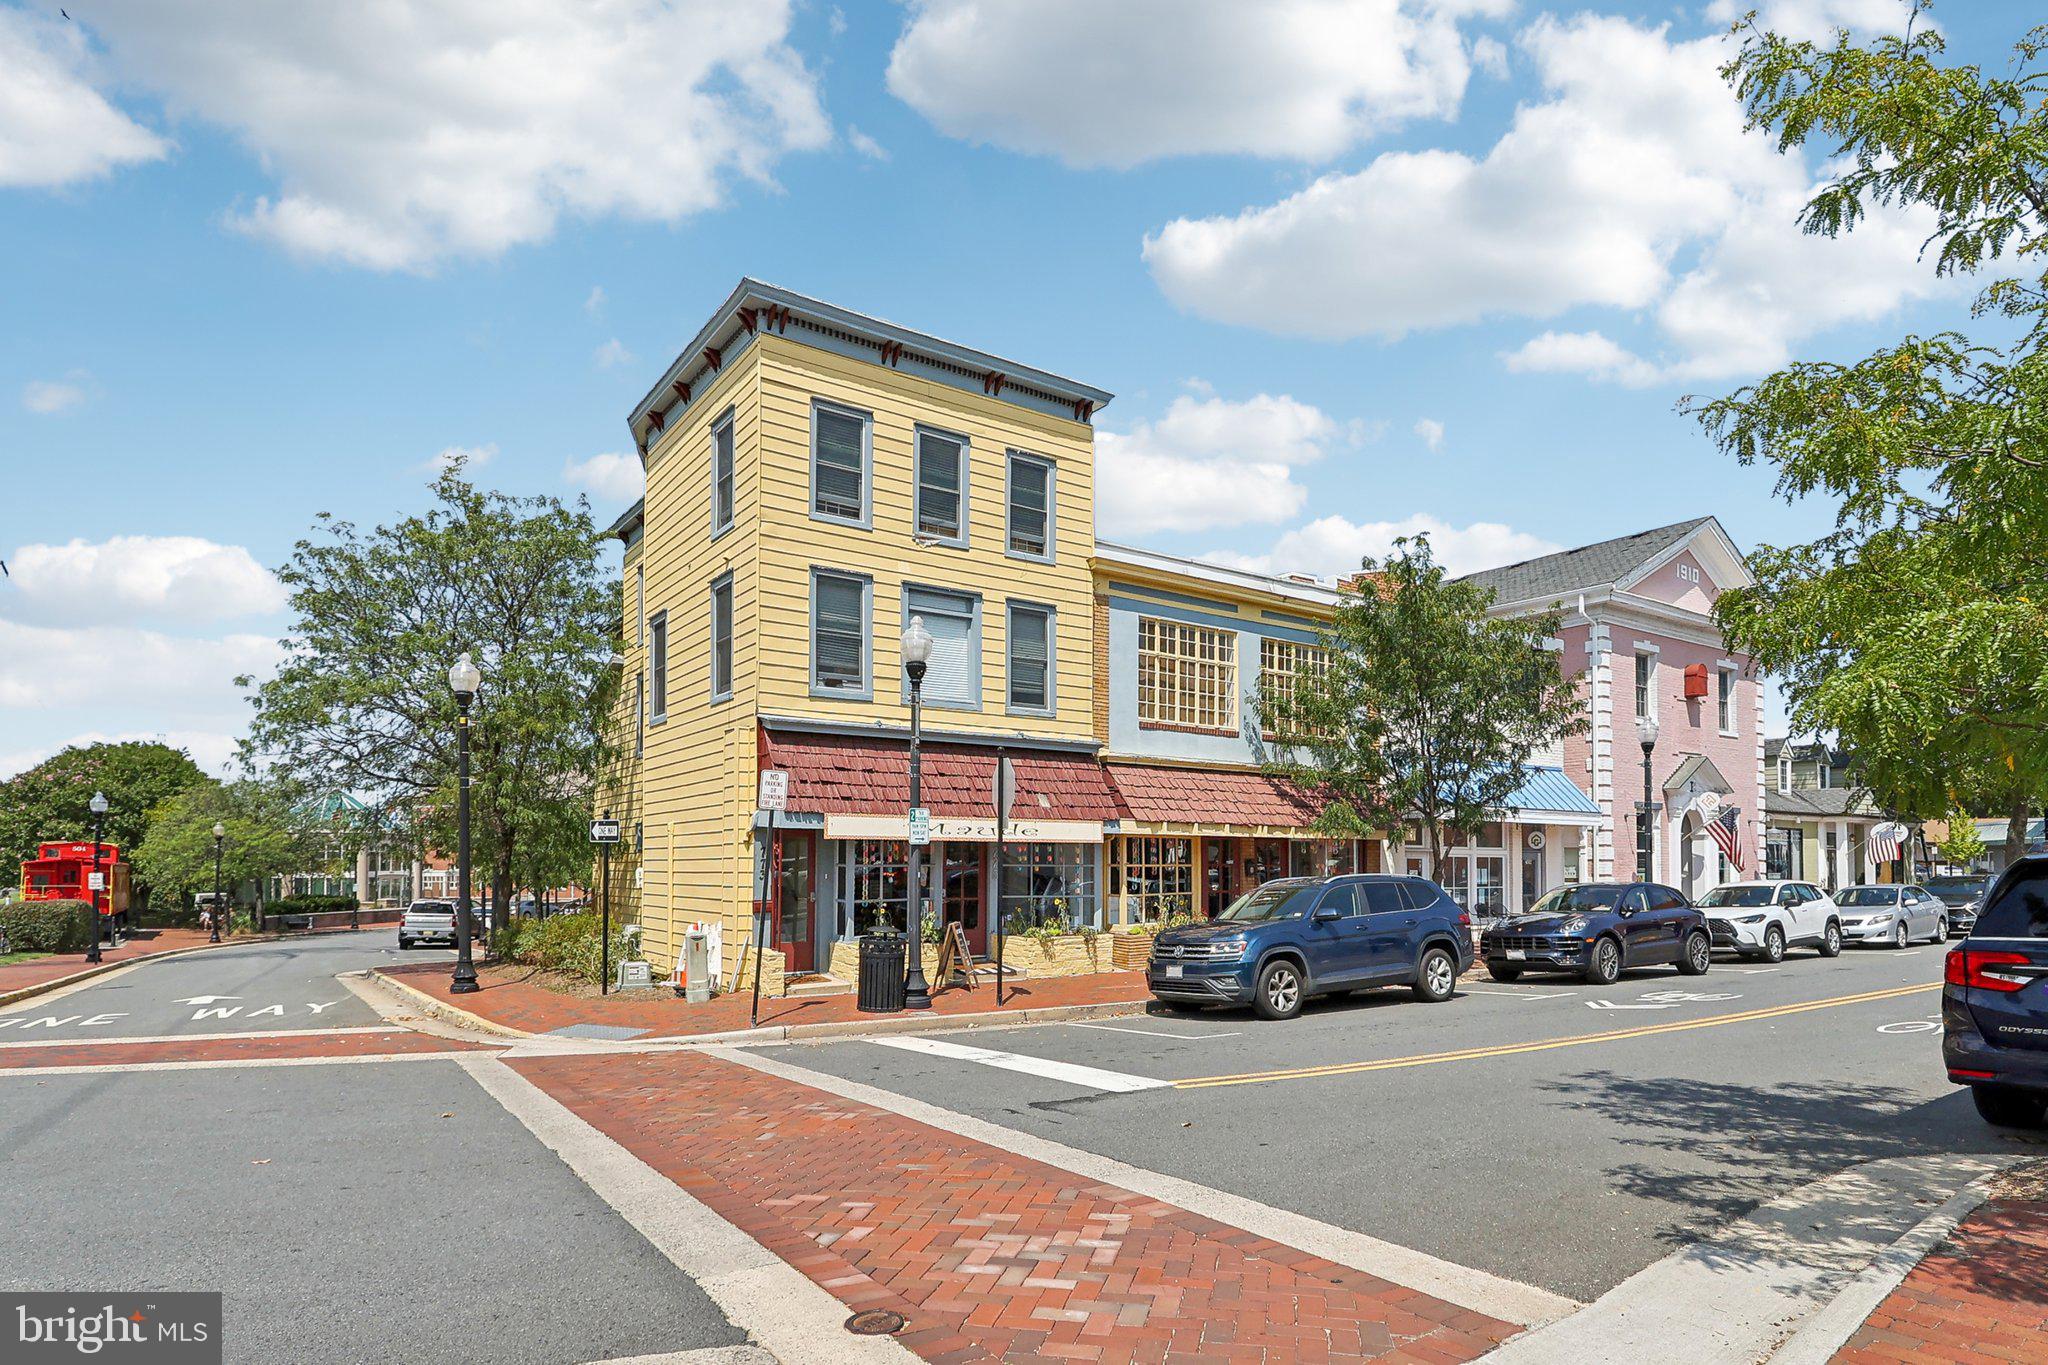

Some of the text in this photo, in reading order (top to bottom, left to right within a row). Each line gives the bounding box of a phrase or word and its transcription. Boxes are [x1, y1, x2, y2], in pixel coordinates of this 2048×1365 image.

[1676, 563, 1699, 583] 1910
[764, 780, 783, 788] PARKING
[762, 793, 783, 801] STANDING
[910, 810, 915, 821] 2
[598, 826, 616, 835] ONE WAY
[191, 1001, 338, 1020] WAY
